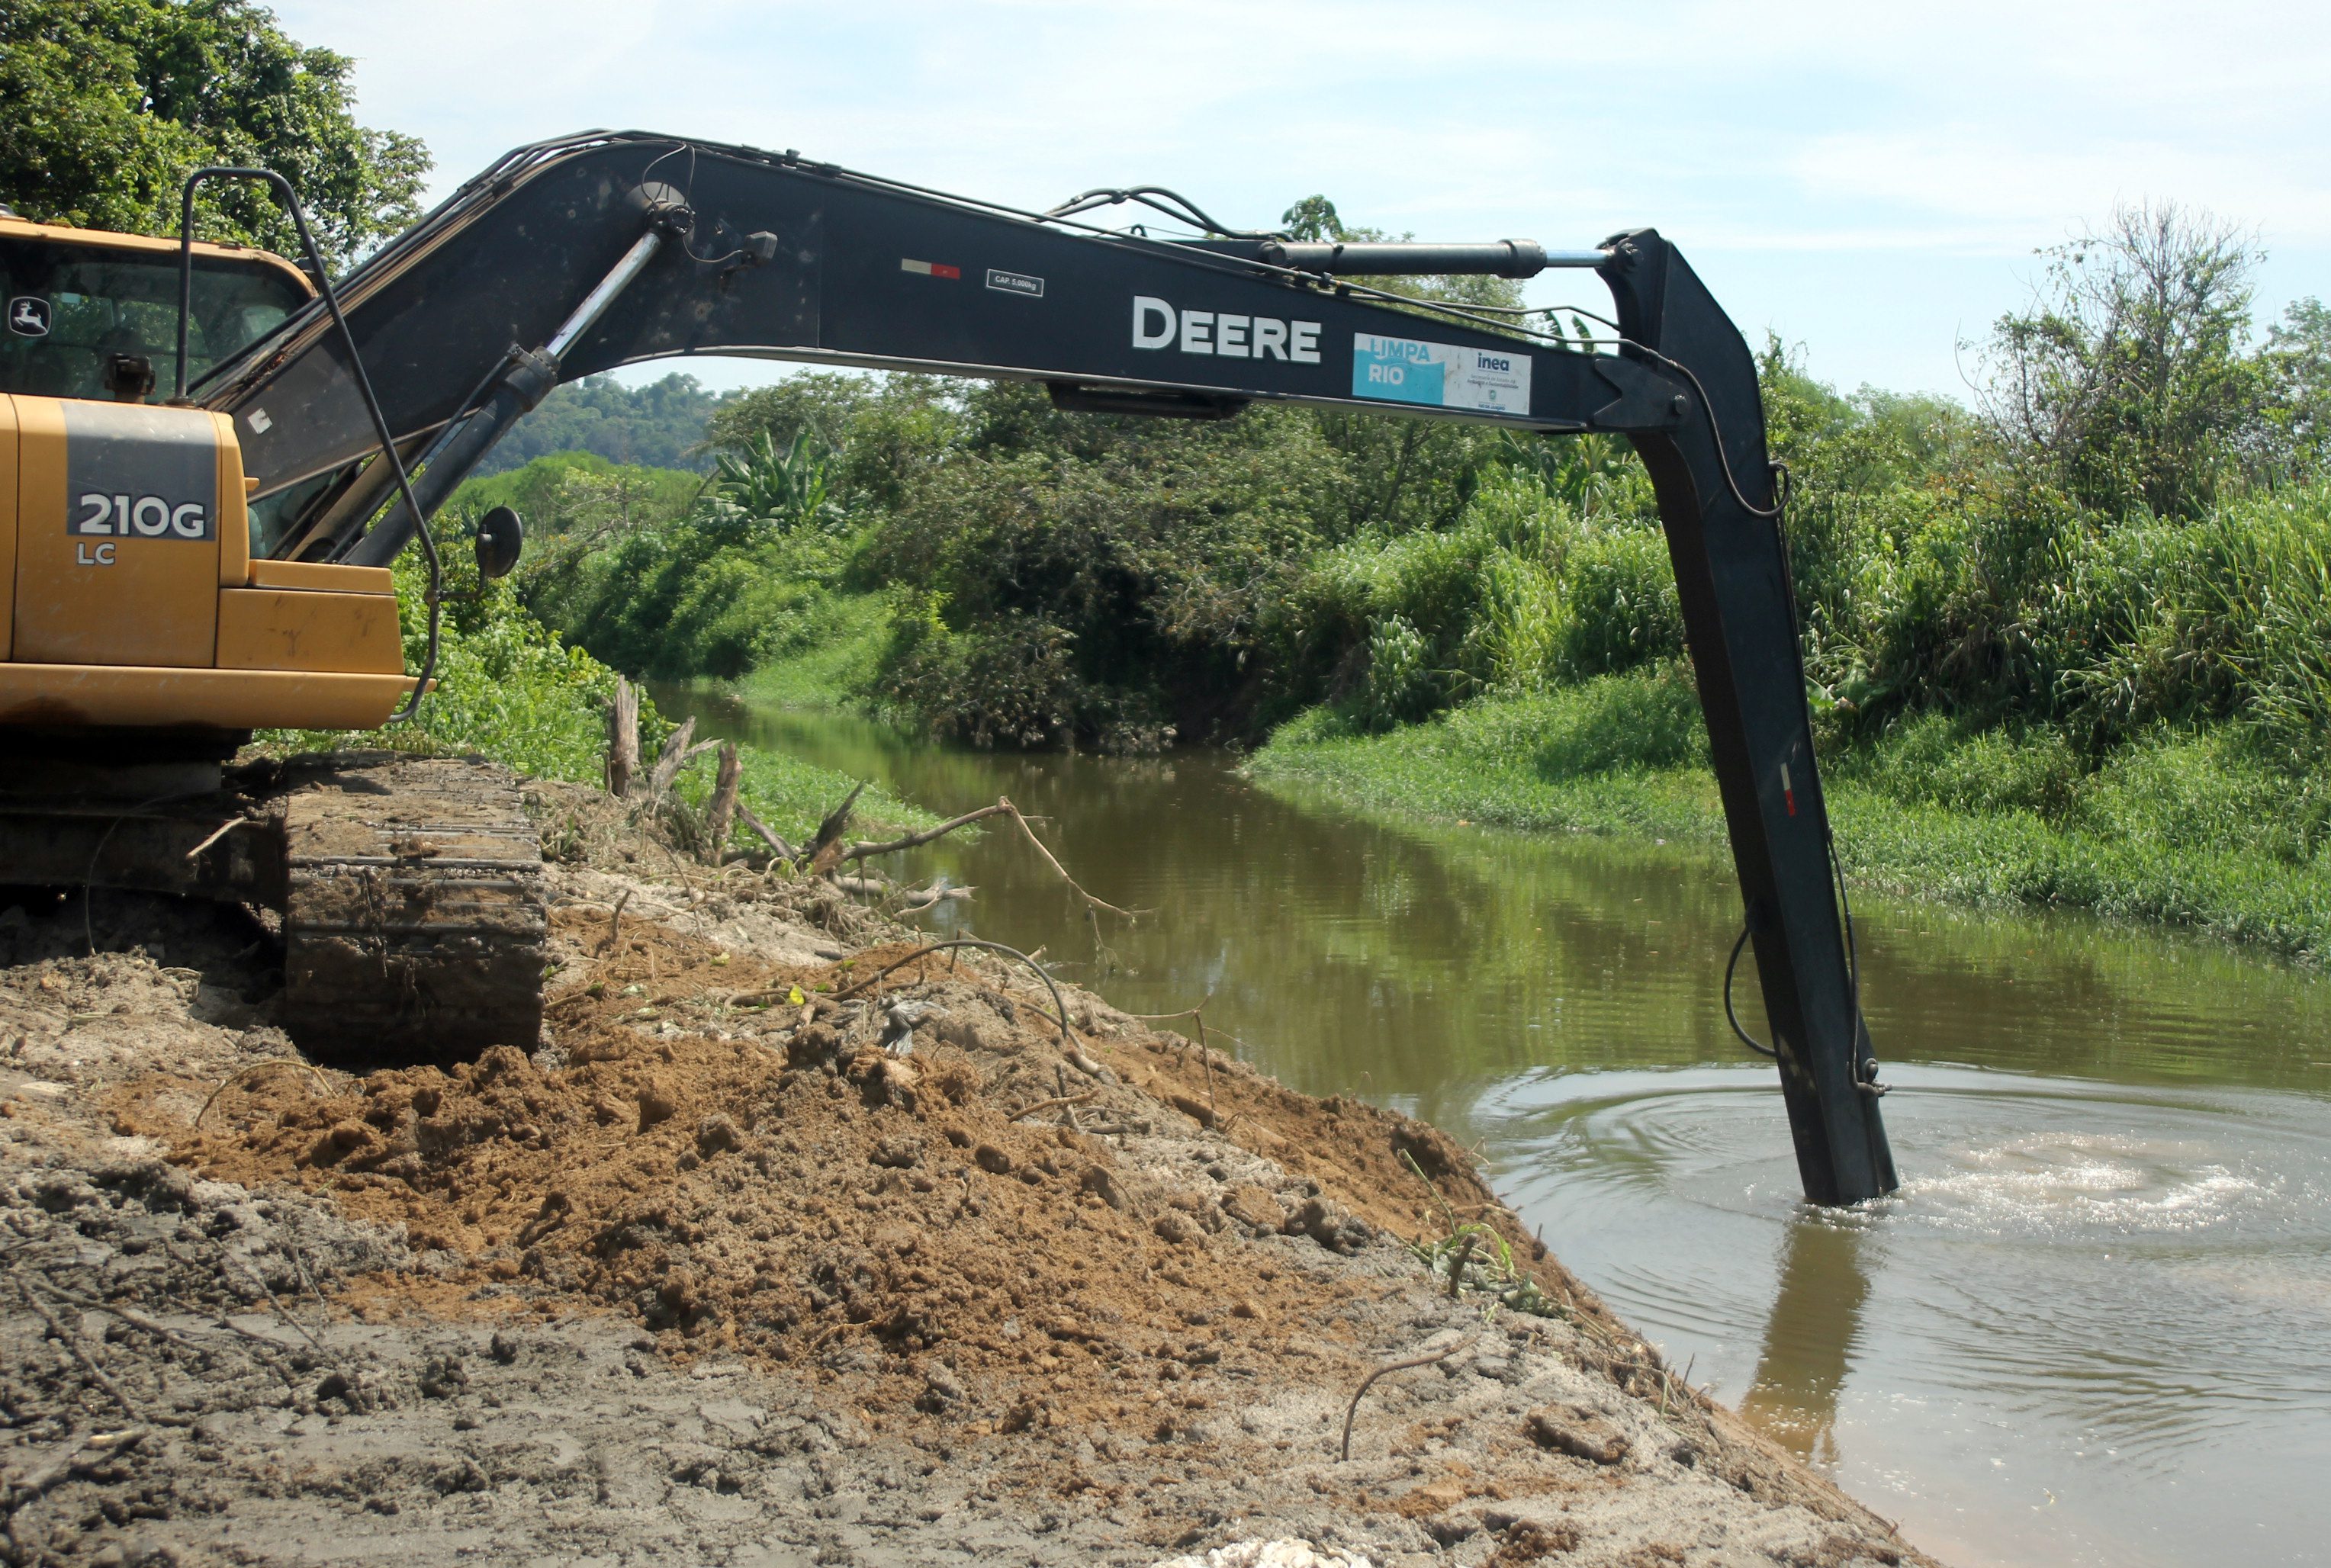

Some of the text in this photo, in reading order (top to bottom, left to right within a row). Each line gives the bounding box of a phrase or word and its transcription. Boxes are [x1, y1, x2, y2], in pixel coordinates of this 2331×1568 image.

[995, 275, 1011, 284] CAP.
[1133, 295, 1322, 363] DEERE
[1370, 338, 1430, 362] LIMPA
[1477, 352, 1510, 371] inea
[1368, 363, 1404, 385] RIO
[79, 493, 204, 538] 210G
[78, 542, 115, 565] LC
